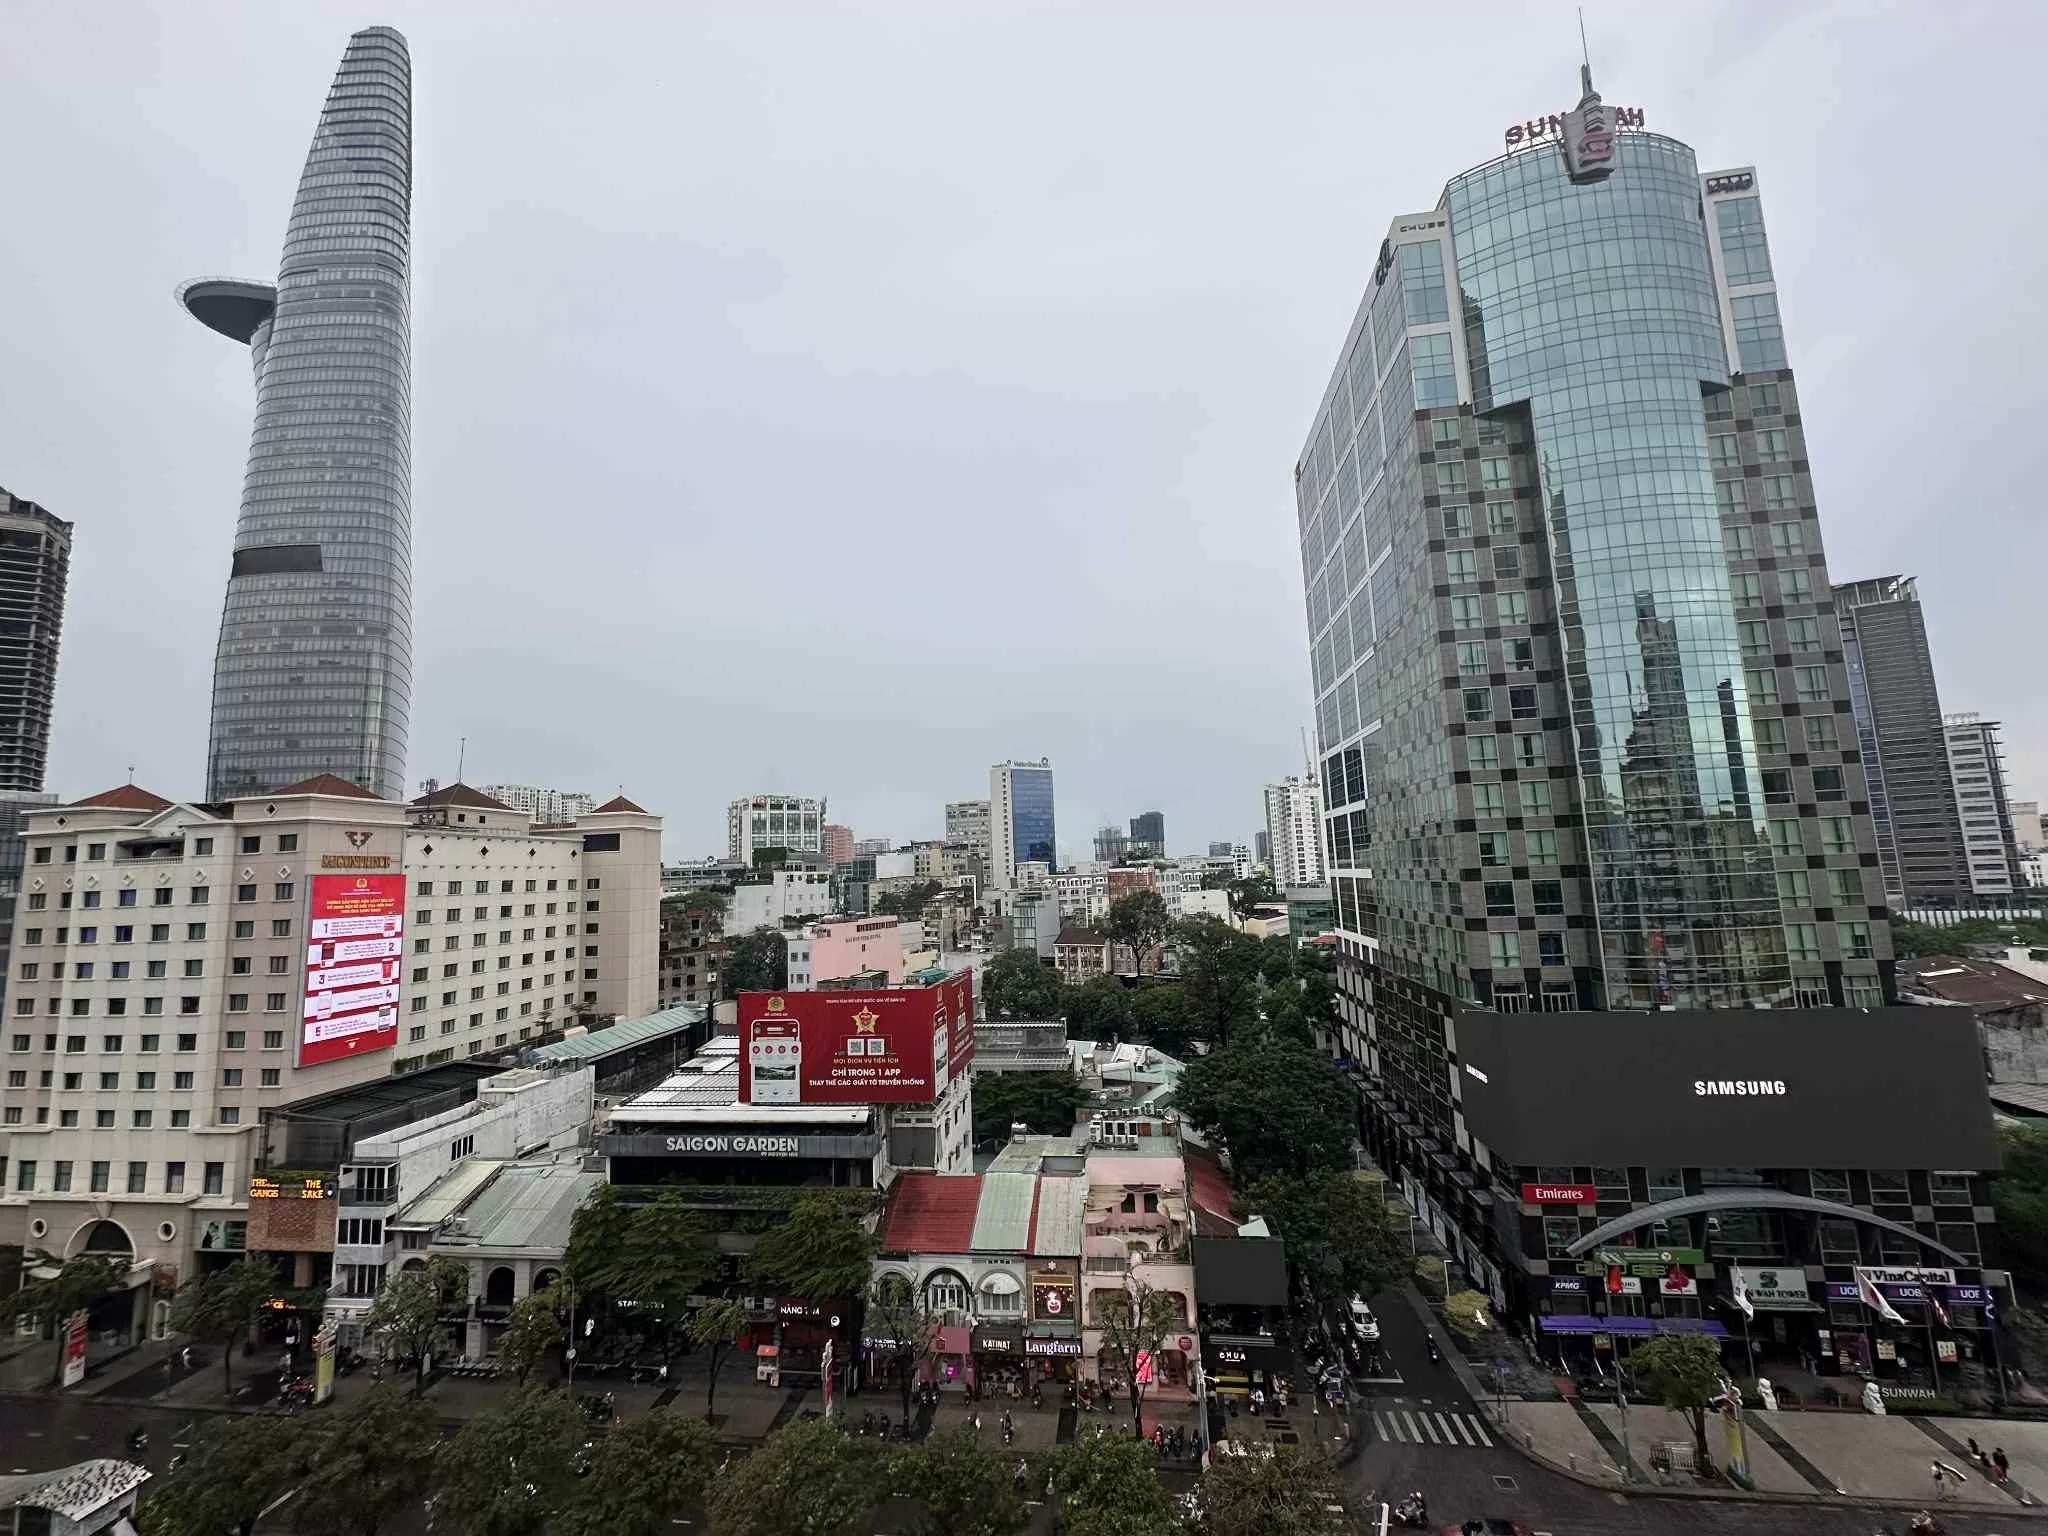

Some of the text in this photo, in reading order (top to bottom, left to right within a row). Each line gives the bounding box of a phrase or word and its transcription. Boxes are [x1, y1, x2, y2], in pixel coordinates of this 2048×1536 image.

[847, 1068, 876, 1076] TRONG
[878, 1068, 882, 1076] 1
[884, 1068, 901, 1076] APP
[1694, 1080, 1786, 1096] SAMSUNG
[666, 1137, 799, 1151] SAIGON GARDEN
[305, 1179, 321, 1189] THE
[301, 1189, 324, 1199] SAKE
[1535, 1187, 1584, 1199] Emirates
[1554, 1281, 1580, 1290] KPMG
[982, 1339, 1010, 1350] KATINAT
[1025, 1340, 1081, 1355] Langfarm
[1881, 1388, 1936, 1399] SUNWAH
